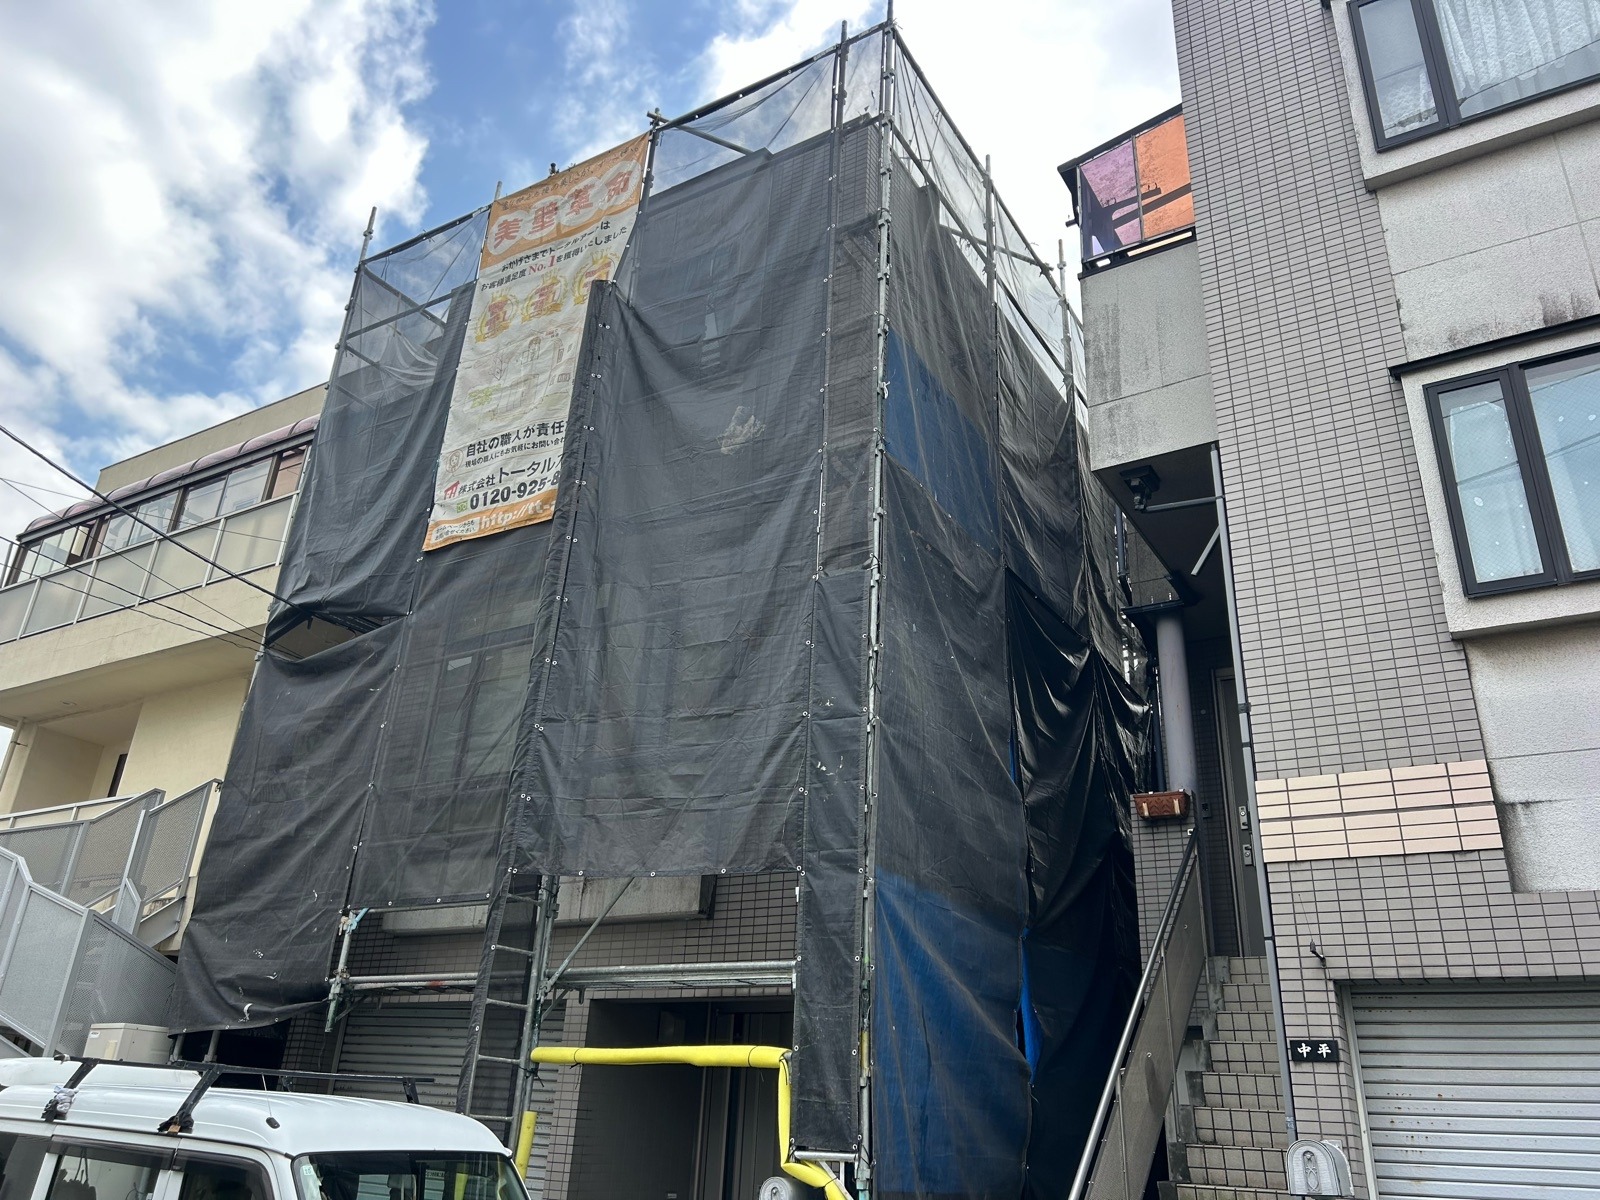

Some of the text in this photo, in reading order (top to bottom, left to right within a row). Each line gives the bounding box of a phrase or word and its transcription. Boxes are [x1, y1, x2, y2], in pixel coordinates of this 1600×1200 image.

[466, 420, 567, 458] 自社の職人が責任
[1297, 1043, 1331, 1058] 中平
